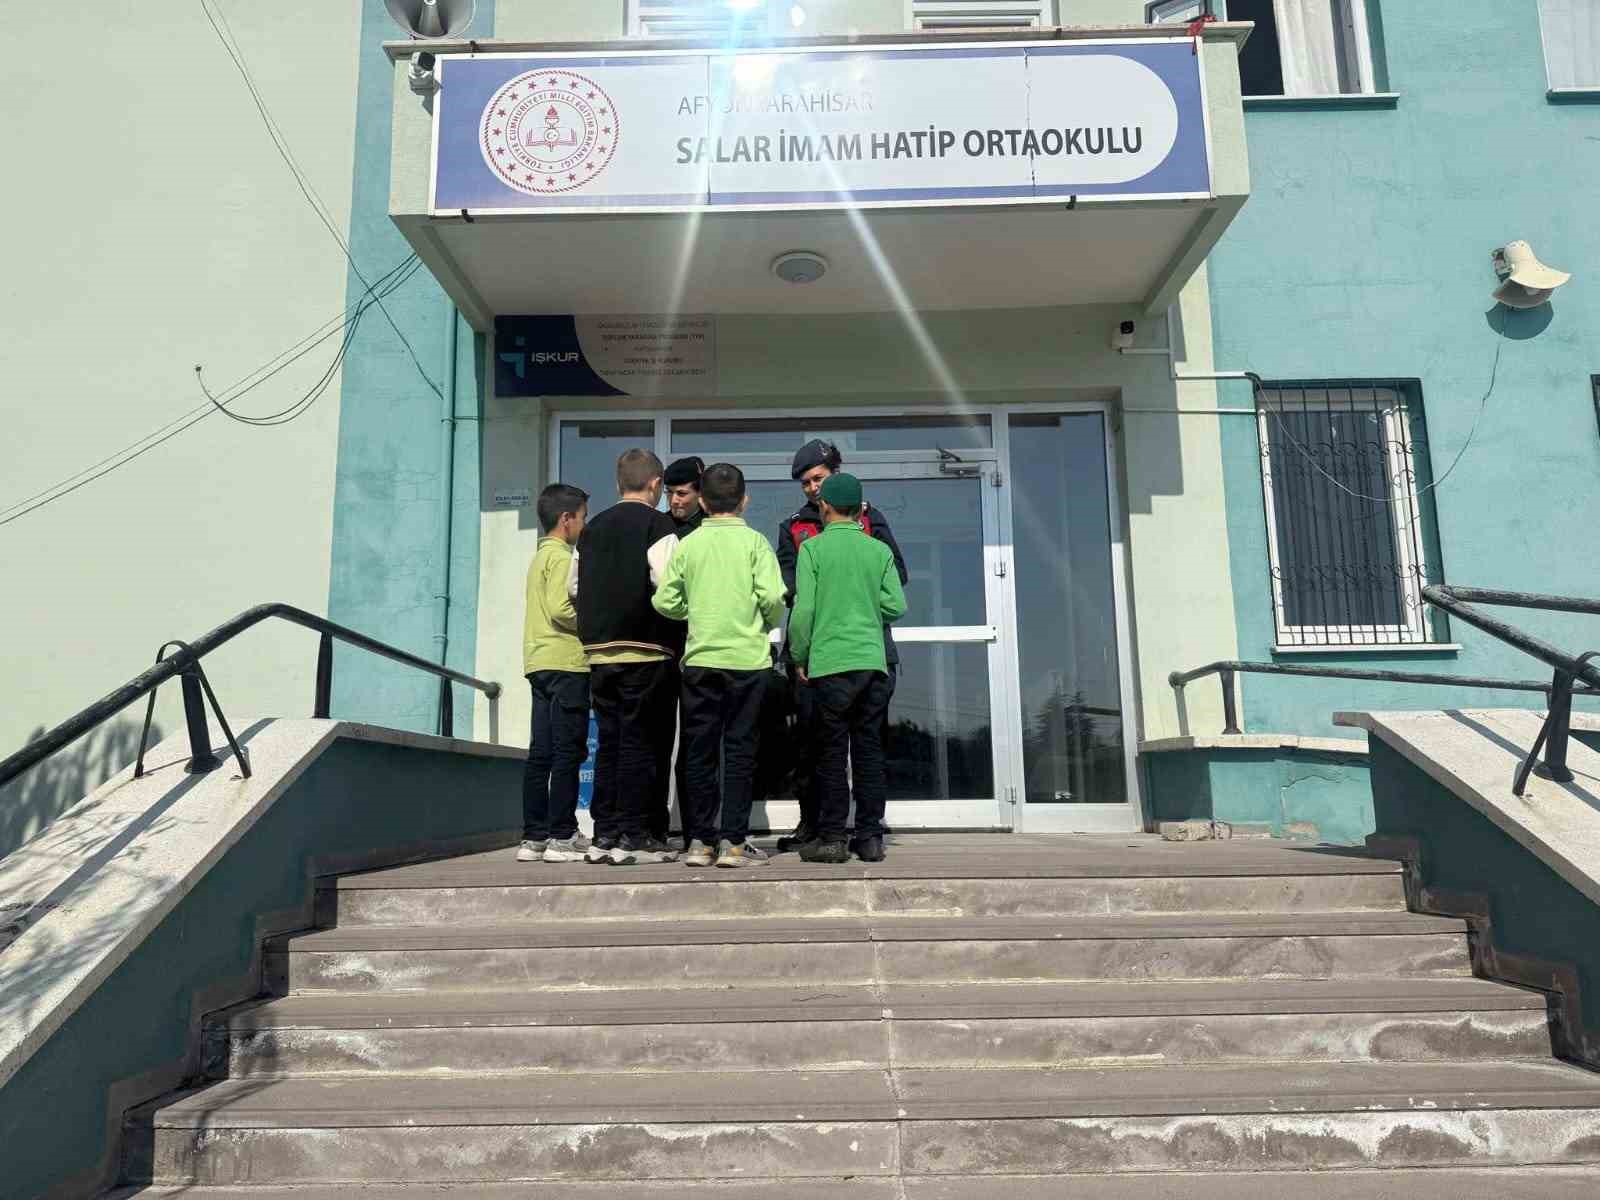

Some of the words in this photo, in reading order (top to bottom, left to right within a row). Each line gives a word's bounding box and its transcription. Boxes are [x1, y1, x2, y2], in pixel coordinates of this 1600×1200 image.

[676, 136, 771, 163] SALAR
[779, 129, 862, 162] İMAM
[871, 125, 955, 159] HATİP
[963, 127, 1142, 157] ORTAOKULU
